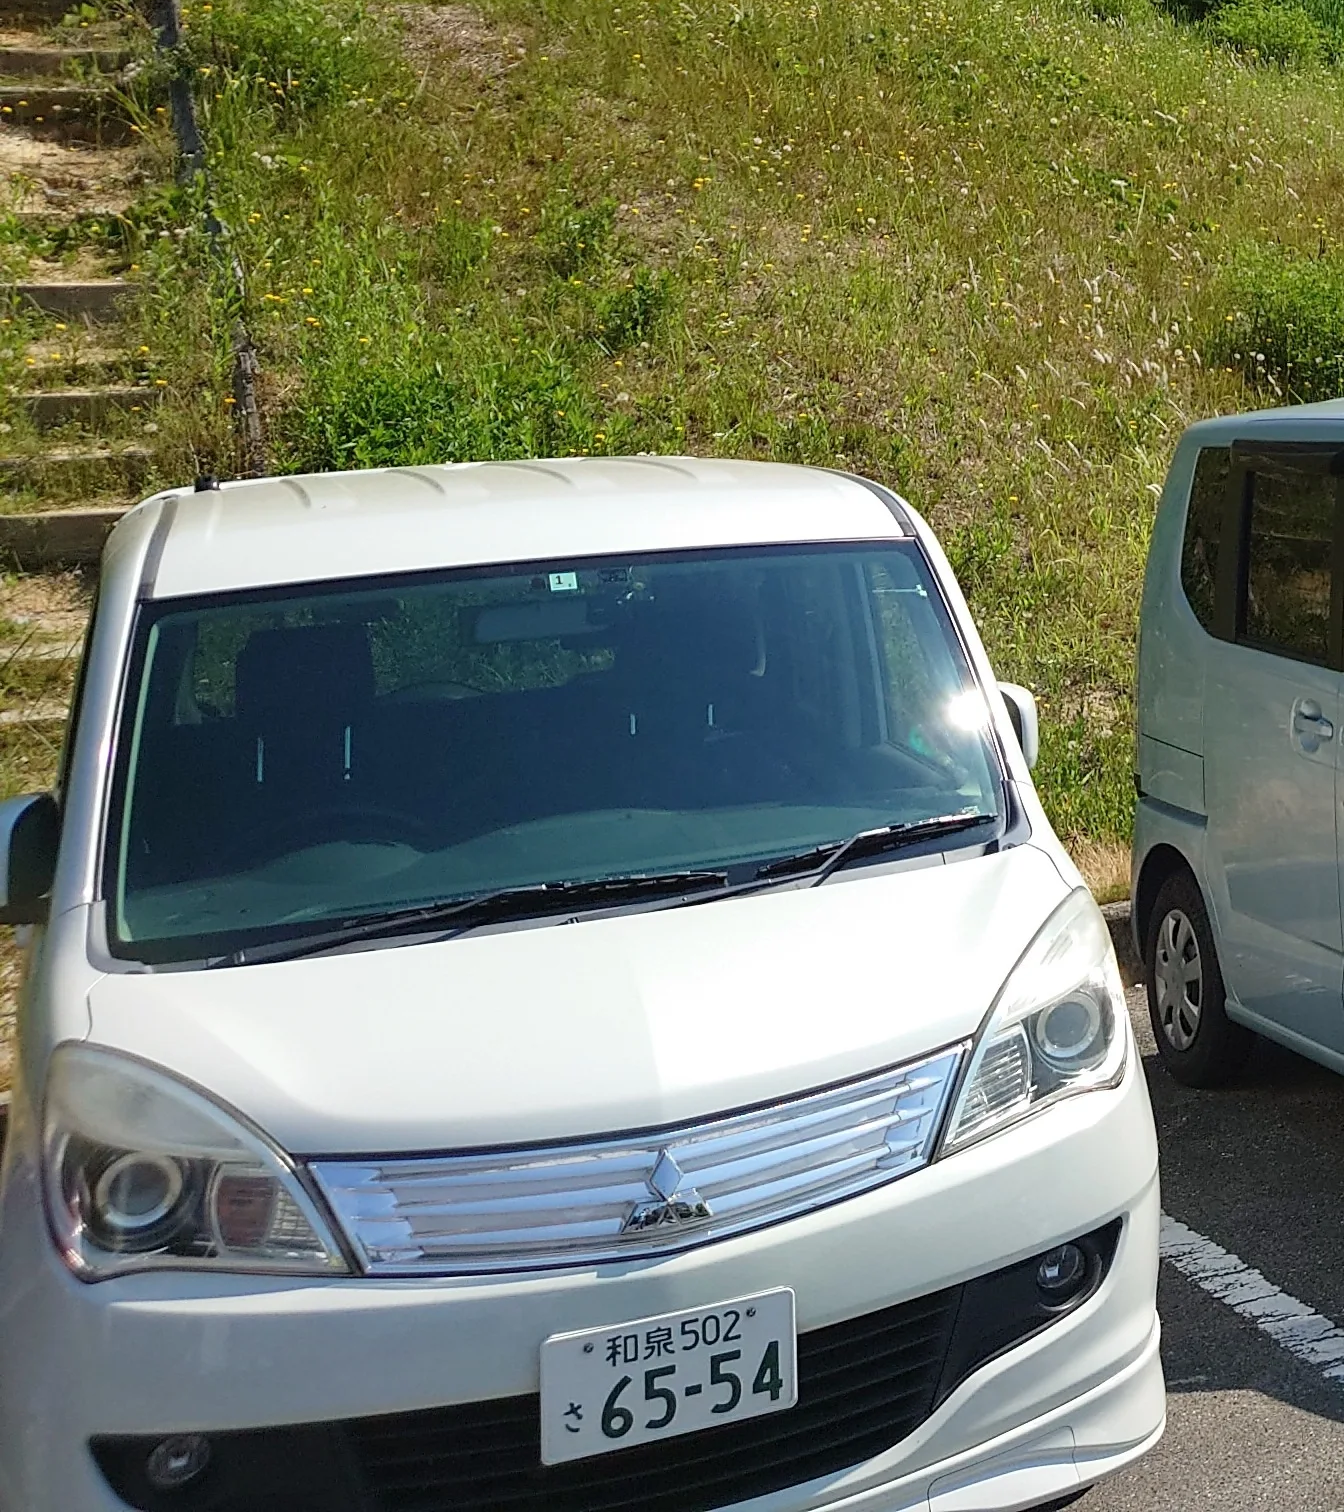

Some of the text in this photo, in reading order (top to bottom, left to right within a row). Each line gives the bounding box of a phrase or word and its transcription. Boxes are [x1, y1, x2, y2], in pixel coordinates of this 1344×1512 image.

[605, 1310, 742, 1367] 和泉502
[562, 1340, 783, 1438] さ 65-54
